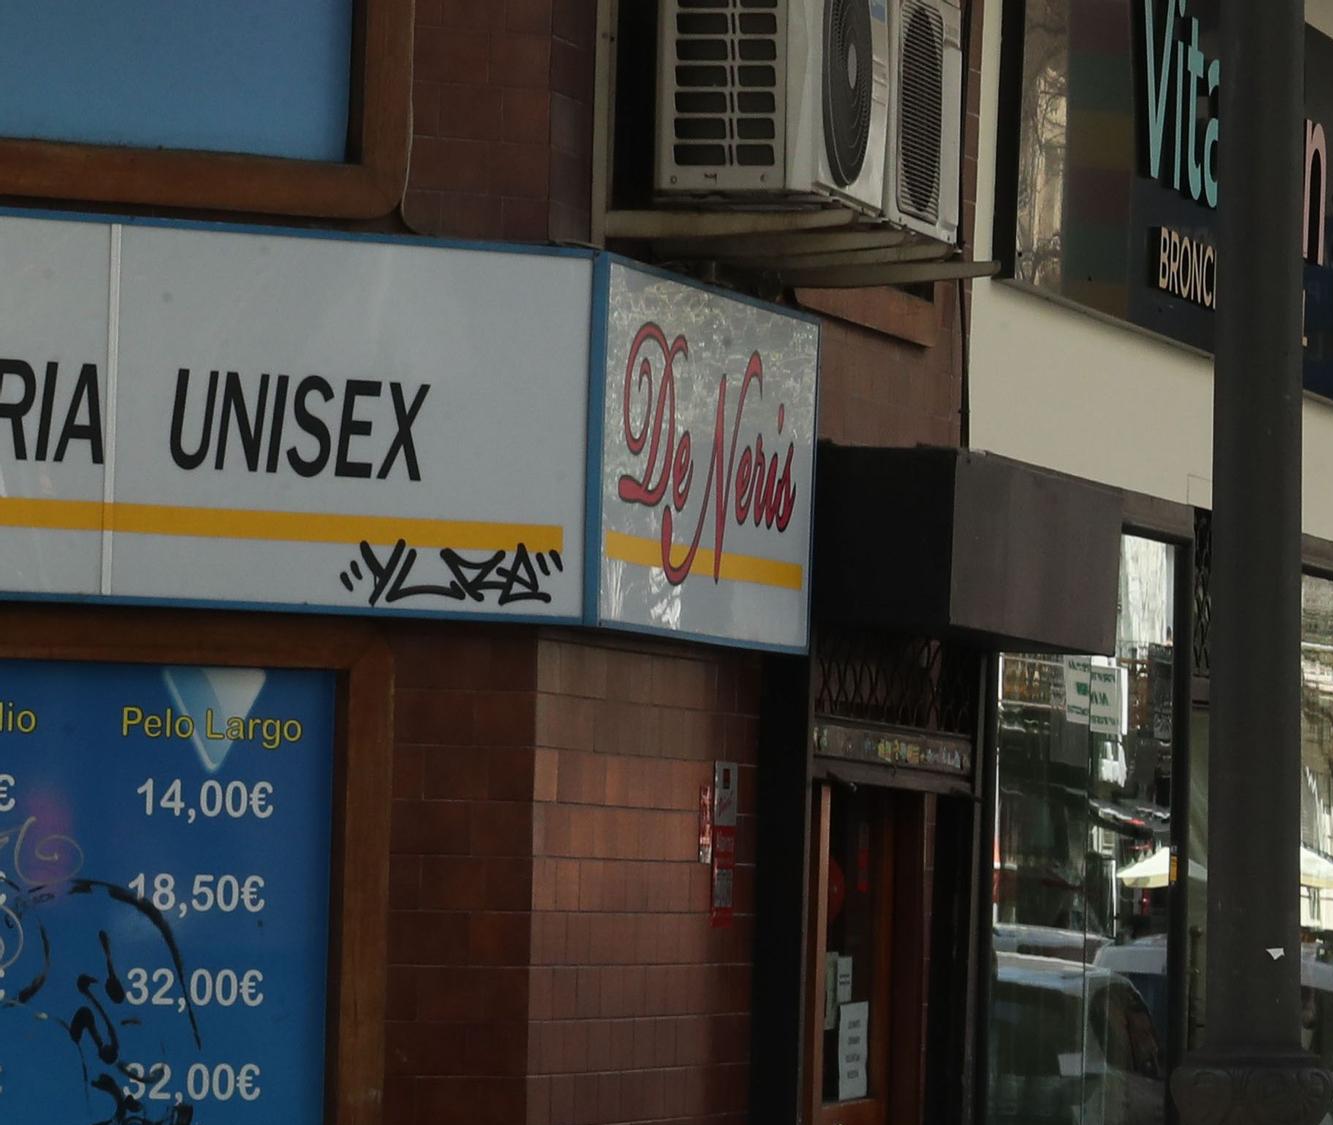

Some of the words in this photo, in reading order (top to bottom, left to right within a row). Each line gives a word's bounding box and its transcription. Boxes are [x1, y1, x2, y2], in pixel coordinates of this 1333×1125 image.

[1158, 226, 1217, 311] BRONC
[168, 368, 432, 482] UNISEX
[617, 319, 694, 512] De
[660, 349, 797, 587] Neris
[121, 706, 195, 739] Pelo
[205, 708, 303, 750] Largo
[136, 777, 275, 825] 14,00€
[128, 872, 266, 919] 18,50€
[125, 967, 265, 1013] 32,00€
[122, 1063, 262, 1105] 32,00€
